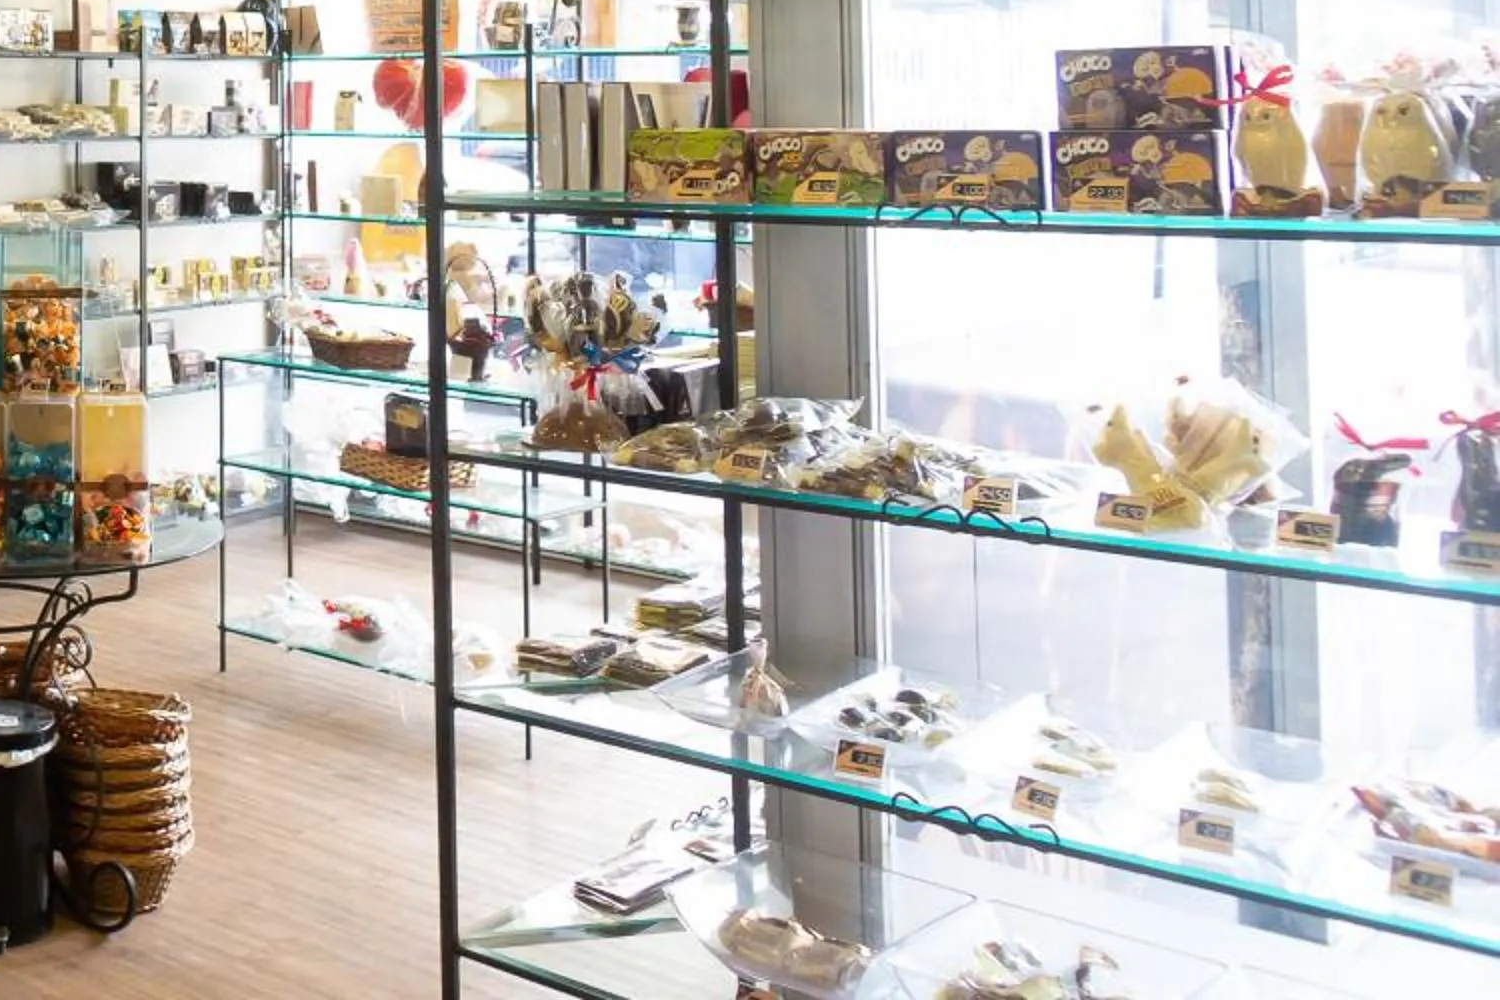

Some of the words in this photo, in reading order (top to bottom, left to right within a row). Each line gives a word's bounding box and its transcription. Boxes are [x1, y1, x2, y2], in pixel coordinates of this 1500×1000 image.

[1060, 55, 1112, 83] CHOCO
[759, 137, 801, 160] CHOCO
[896, 137, 945, 163] CHOCO
[1056, 136, 1109, 164] CHOCO
